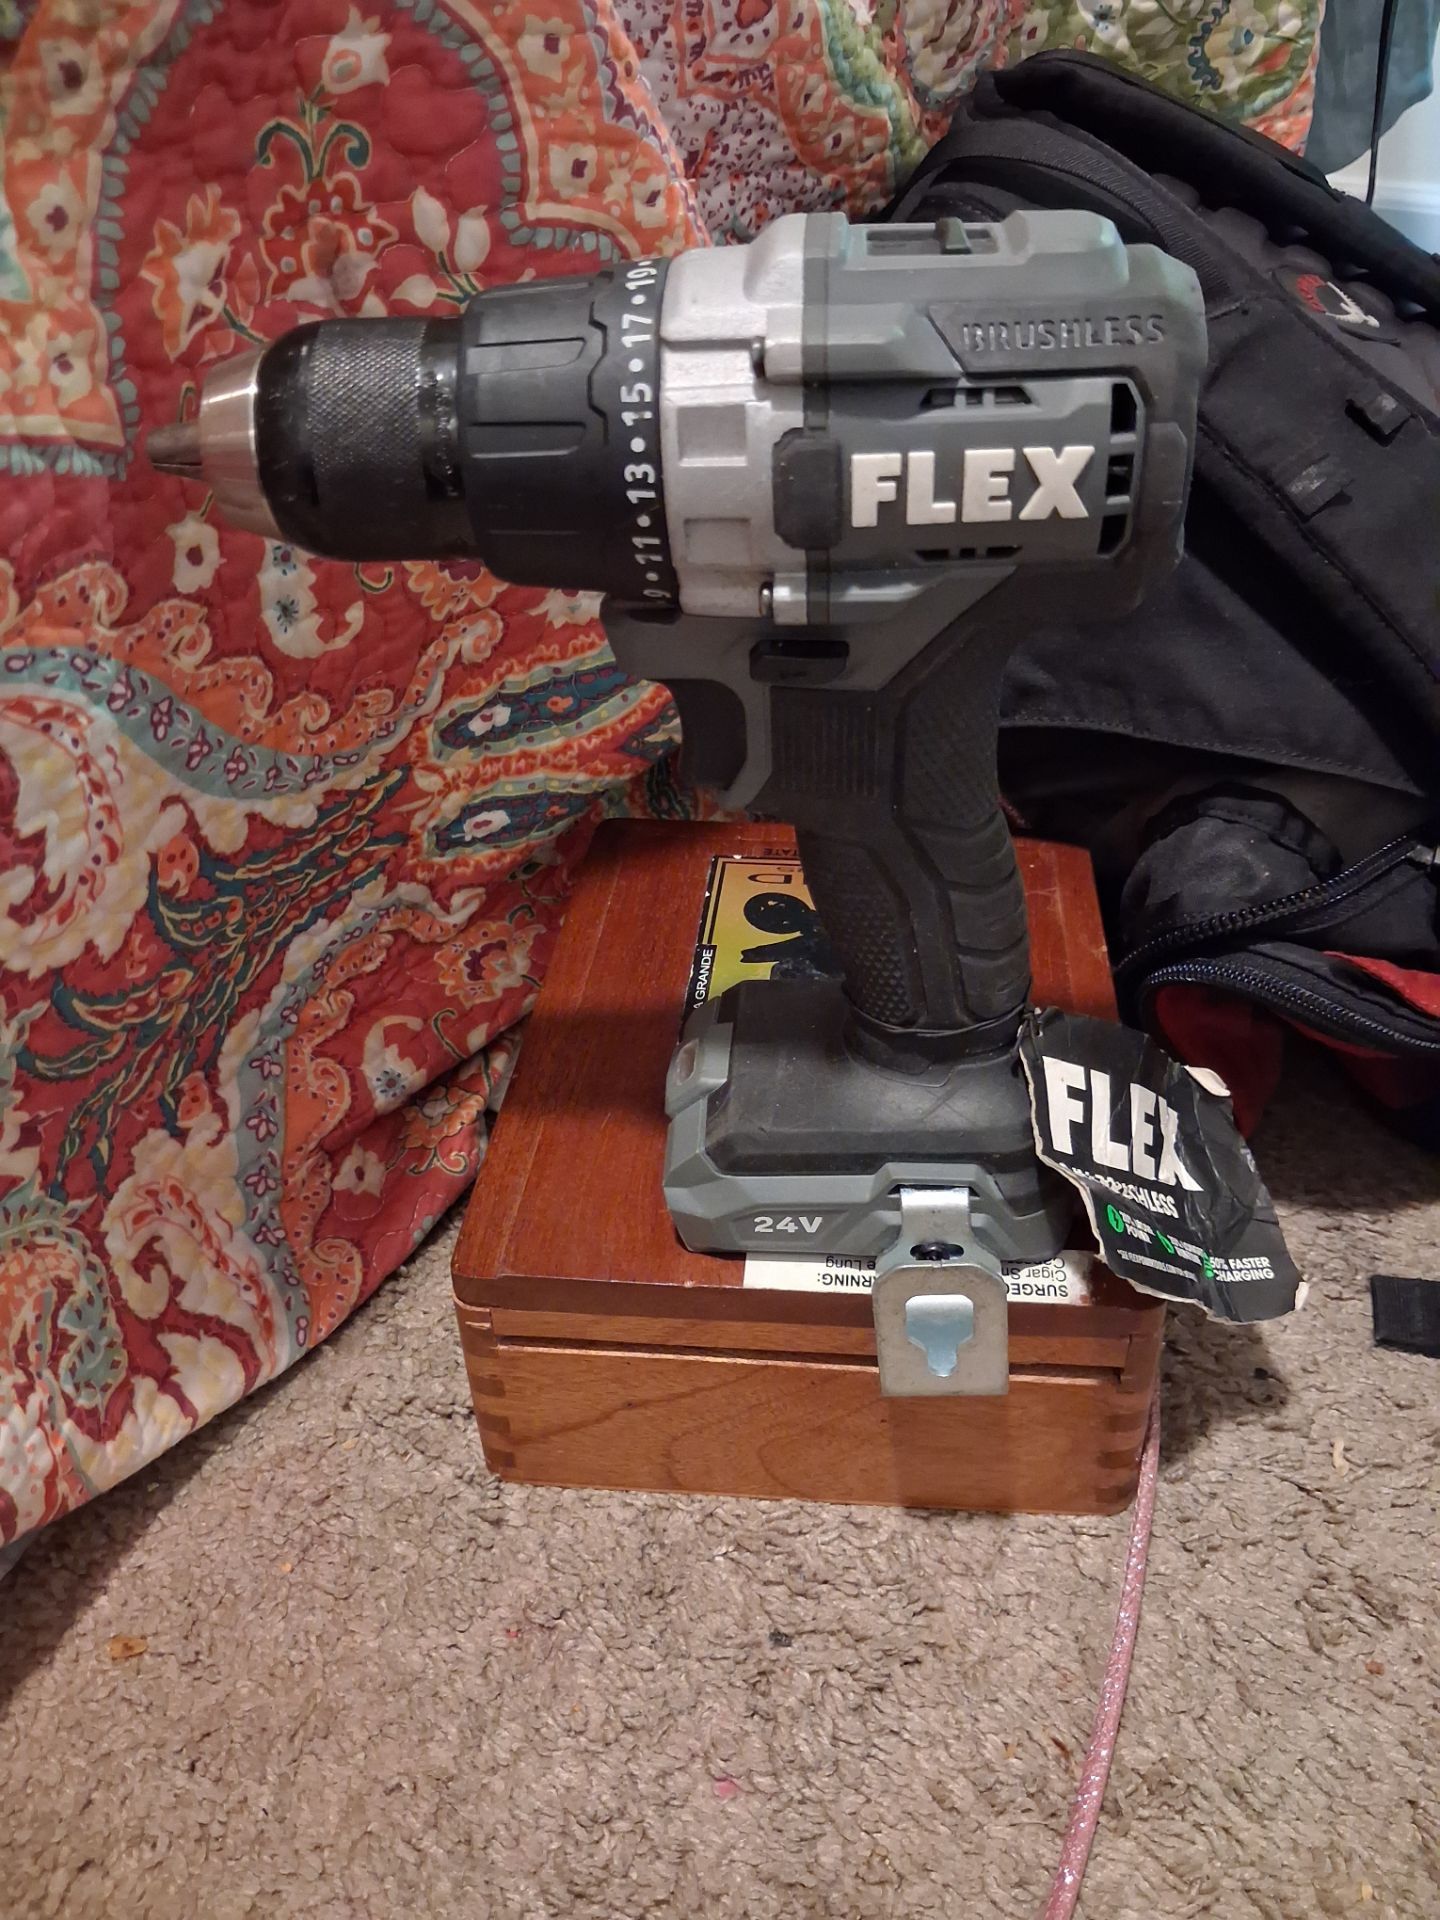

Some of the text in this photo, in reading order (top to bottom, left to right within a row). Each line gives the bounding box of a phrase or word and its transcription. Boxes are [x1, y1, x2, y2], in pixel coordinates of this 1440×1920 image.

[625, 267, 657, 290] 19
[621, 313, 653, 348] 17
[962, 315, 1165, 351] BRUSHLESS
[620, 382, 653, 426] 15
[624, 463, 656, 504] 13
[851, 446, 1096, 528] FLEX
[632, 536, 663, 565] 11
[763, 848, 799, 857] TATE
[695, 949, 713, 1000] GRANDE
[1042, 1056, 1205, 1192] FLEX
[753, 1216, 824, 1234] 24V
[825, 1255, 862, 1272] Lung
[1025, 1266, 1067, 1282] Cigar
[1227, 1256, 1273, 1270] FASTER
[817, 1272, 1069, 1298] SURGE RNING:
